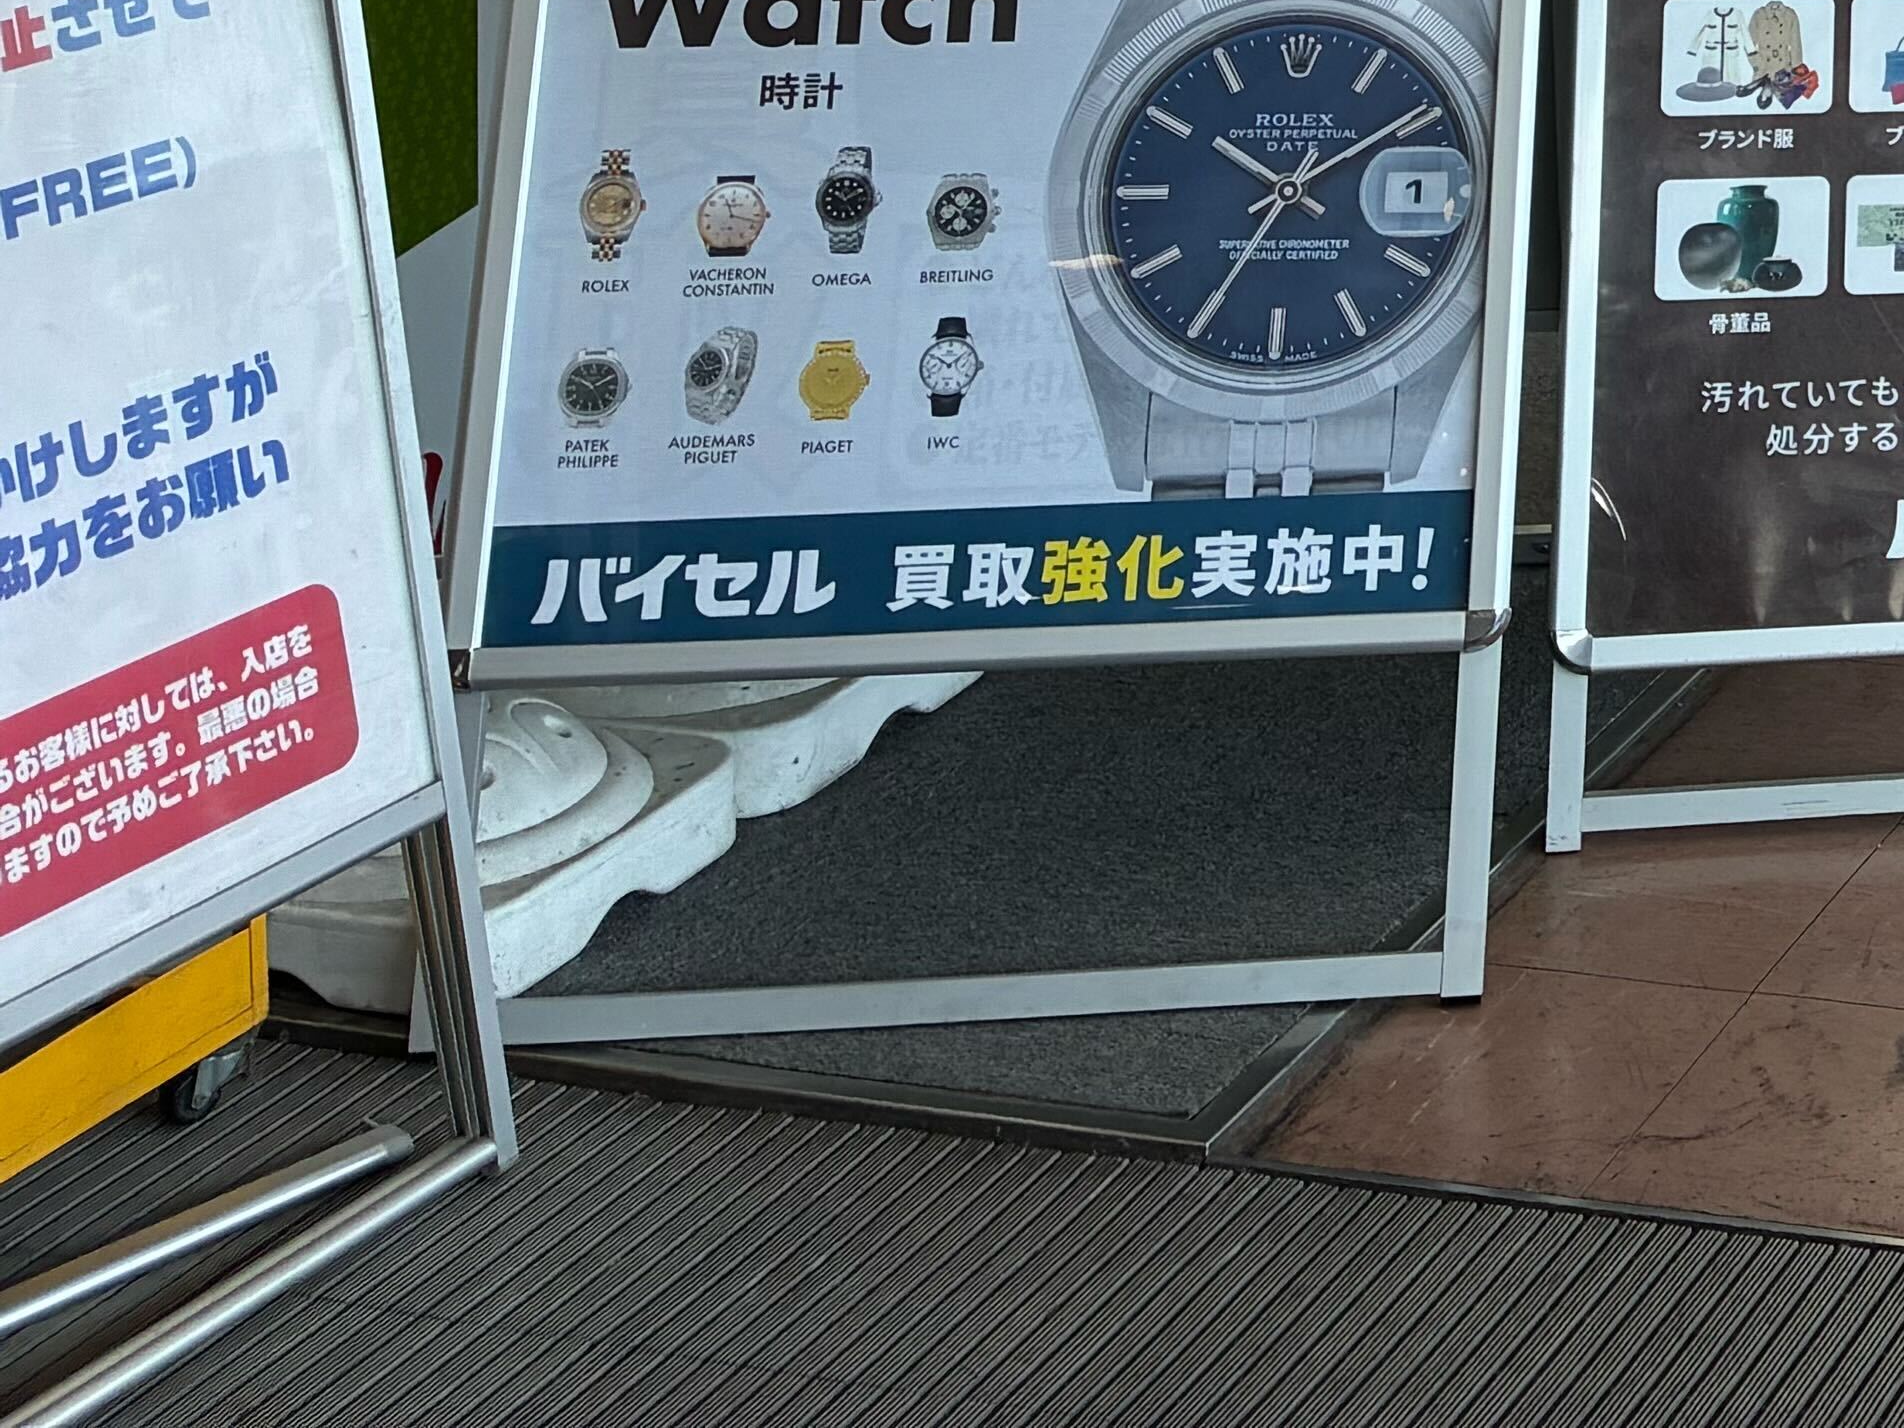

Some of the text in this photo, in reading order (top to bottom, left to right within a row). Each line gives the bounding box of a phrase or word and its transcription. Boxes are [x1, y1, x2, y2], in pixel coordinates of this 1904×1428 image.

[758, 71, 844, 110] 時計
[1255, 112, 1334, 127] ROLEX
[1229, 128, 1358, 140] OYSTER PERPETUAL
[1698, 127, 1794, 151] ブランド服
[1, 136, 197, 240] FREE)
[1405, 179, 1423, 204] 1
[688, 267, 767, 282] VACHERON
[811, 272, 872, 287] OMEGA
[919, 269, 994, 285] BREITLING
[581, 279, 630, 294] ROLEX
[682, 283, 775, 298] CONSTANTIN
[1709, 311, 1770, 335] 骨董品
[565, 439, 610, 454] PATEK
[668, 434, 756, 450] AUDEMARS
[801, 440, 853, 455] PIAGET
[927, 436, 960, 450] IWC
[557, 454, 619, 469] PHILIPPE
[683, 449, 737, 465] PIGUET
[532, 526, 1431, 626] バイセル 買取強化実施中!
